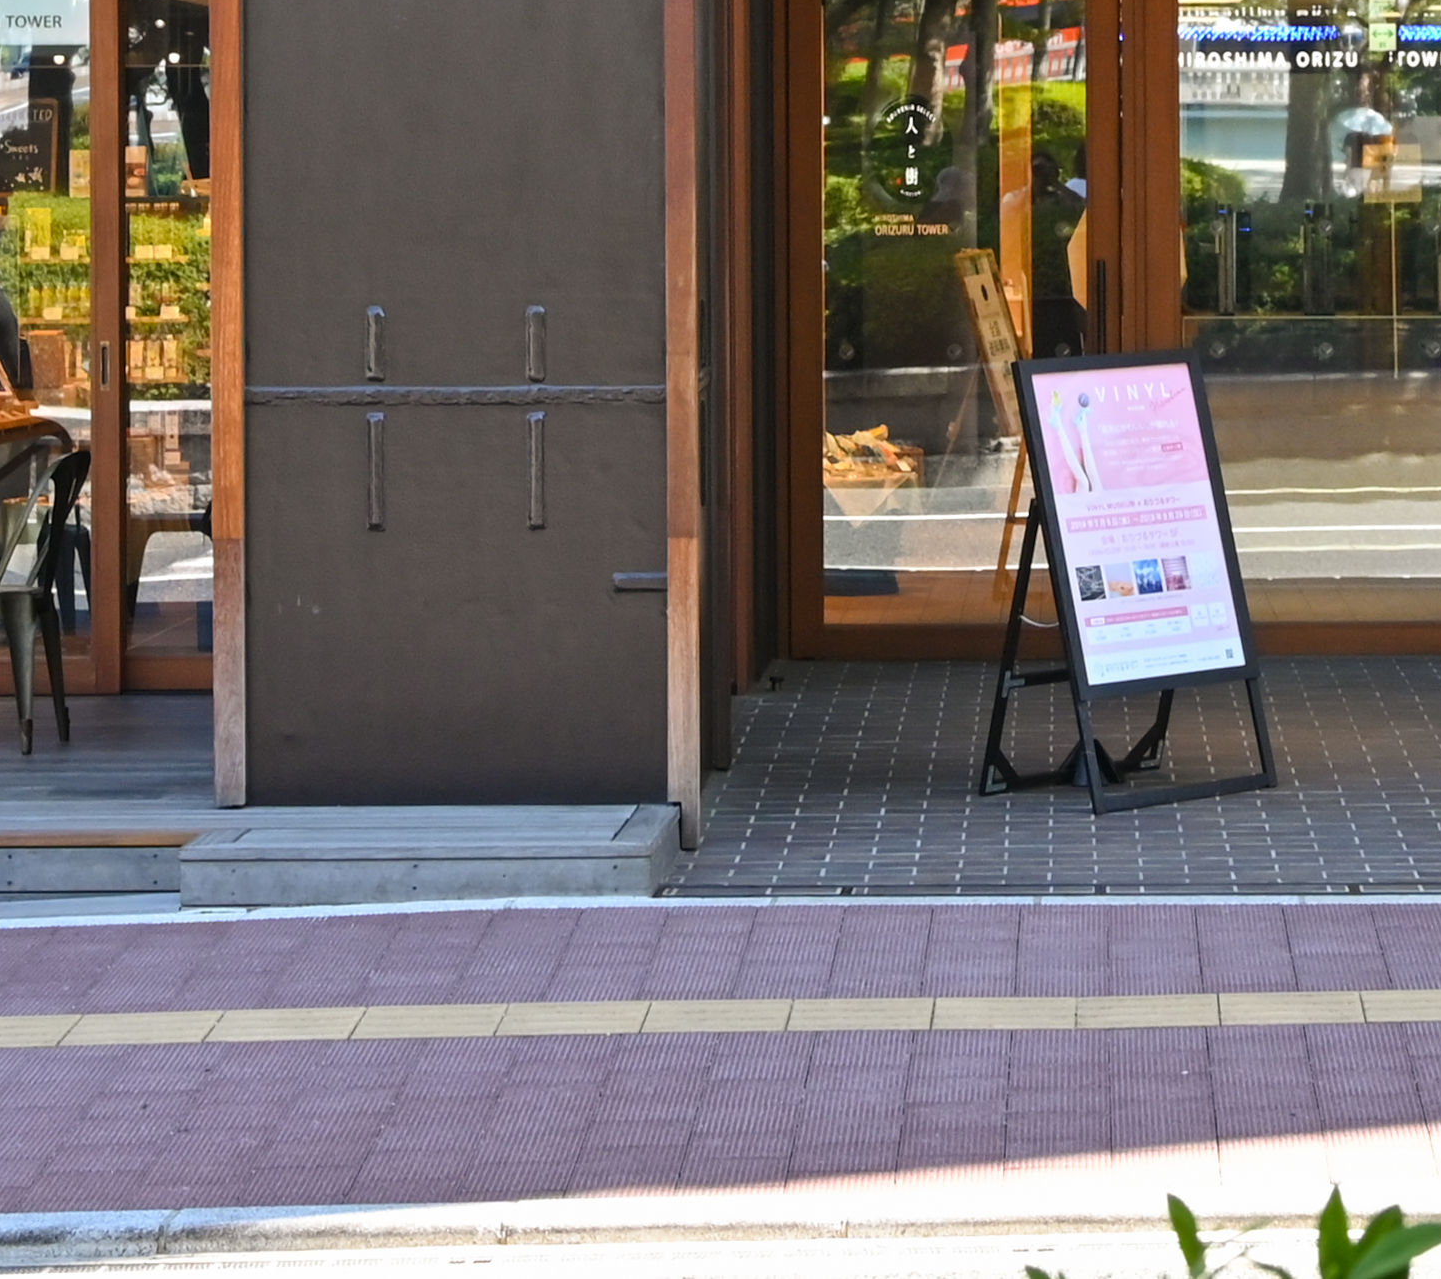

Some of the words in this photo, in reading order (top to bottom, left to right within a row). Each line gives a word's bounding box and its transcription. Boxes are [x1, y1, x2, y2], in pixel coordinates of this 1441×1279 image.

[6, 15, 63, 29] TOWER
[905, 116, 919, 186] 人と樹
[875, 224, 915, 236] ORIZURU
[916, 223, 949, 236] TOWER
[1094, 381, 1171, 403] VINYL
